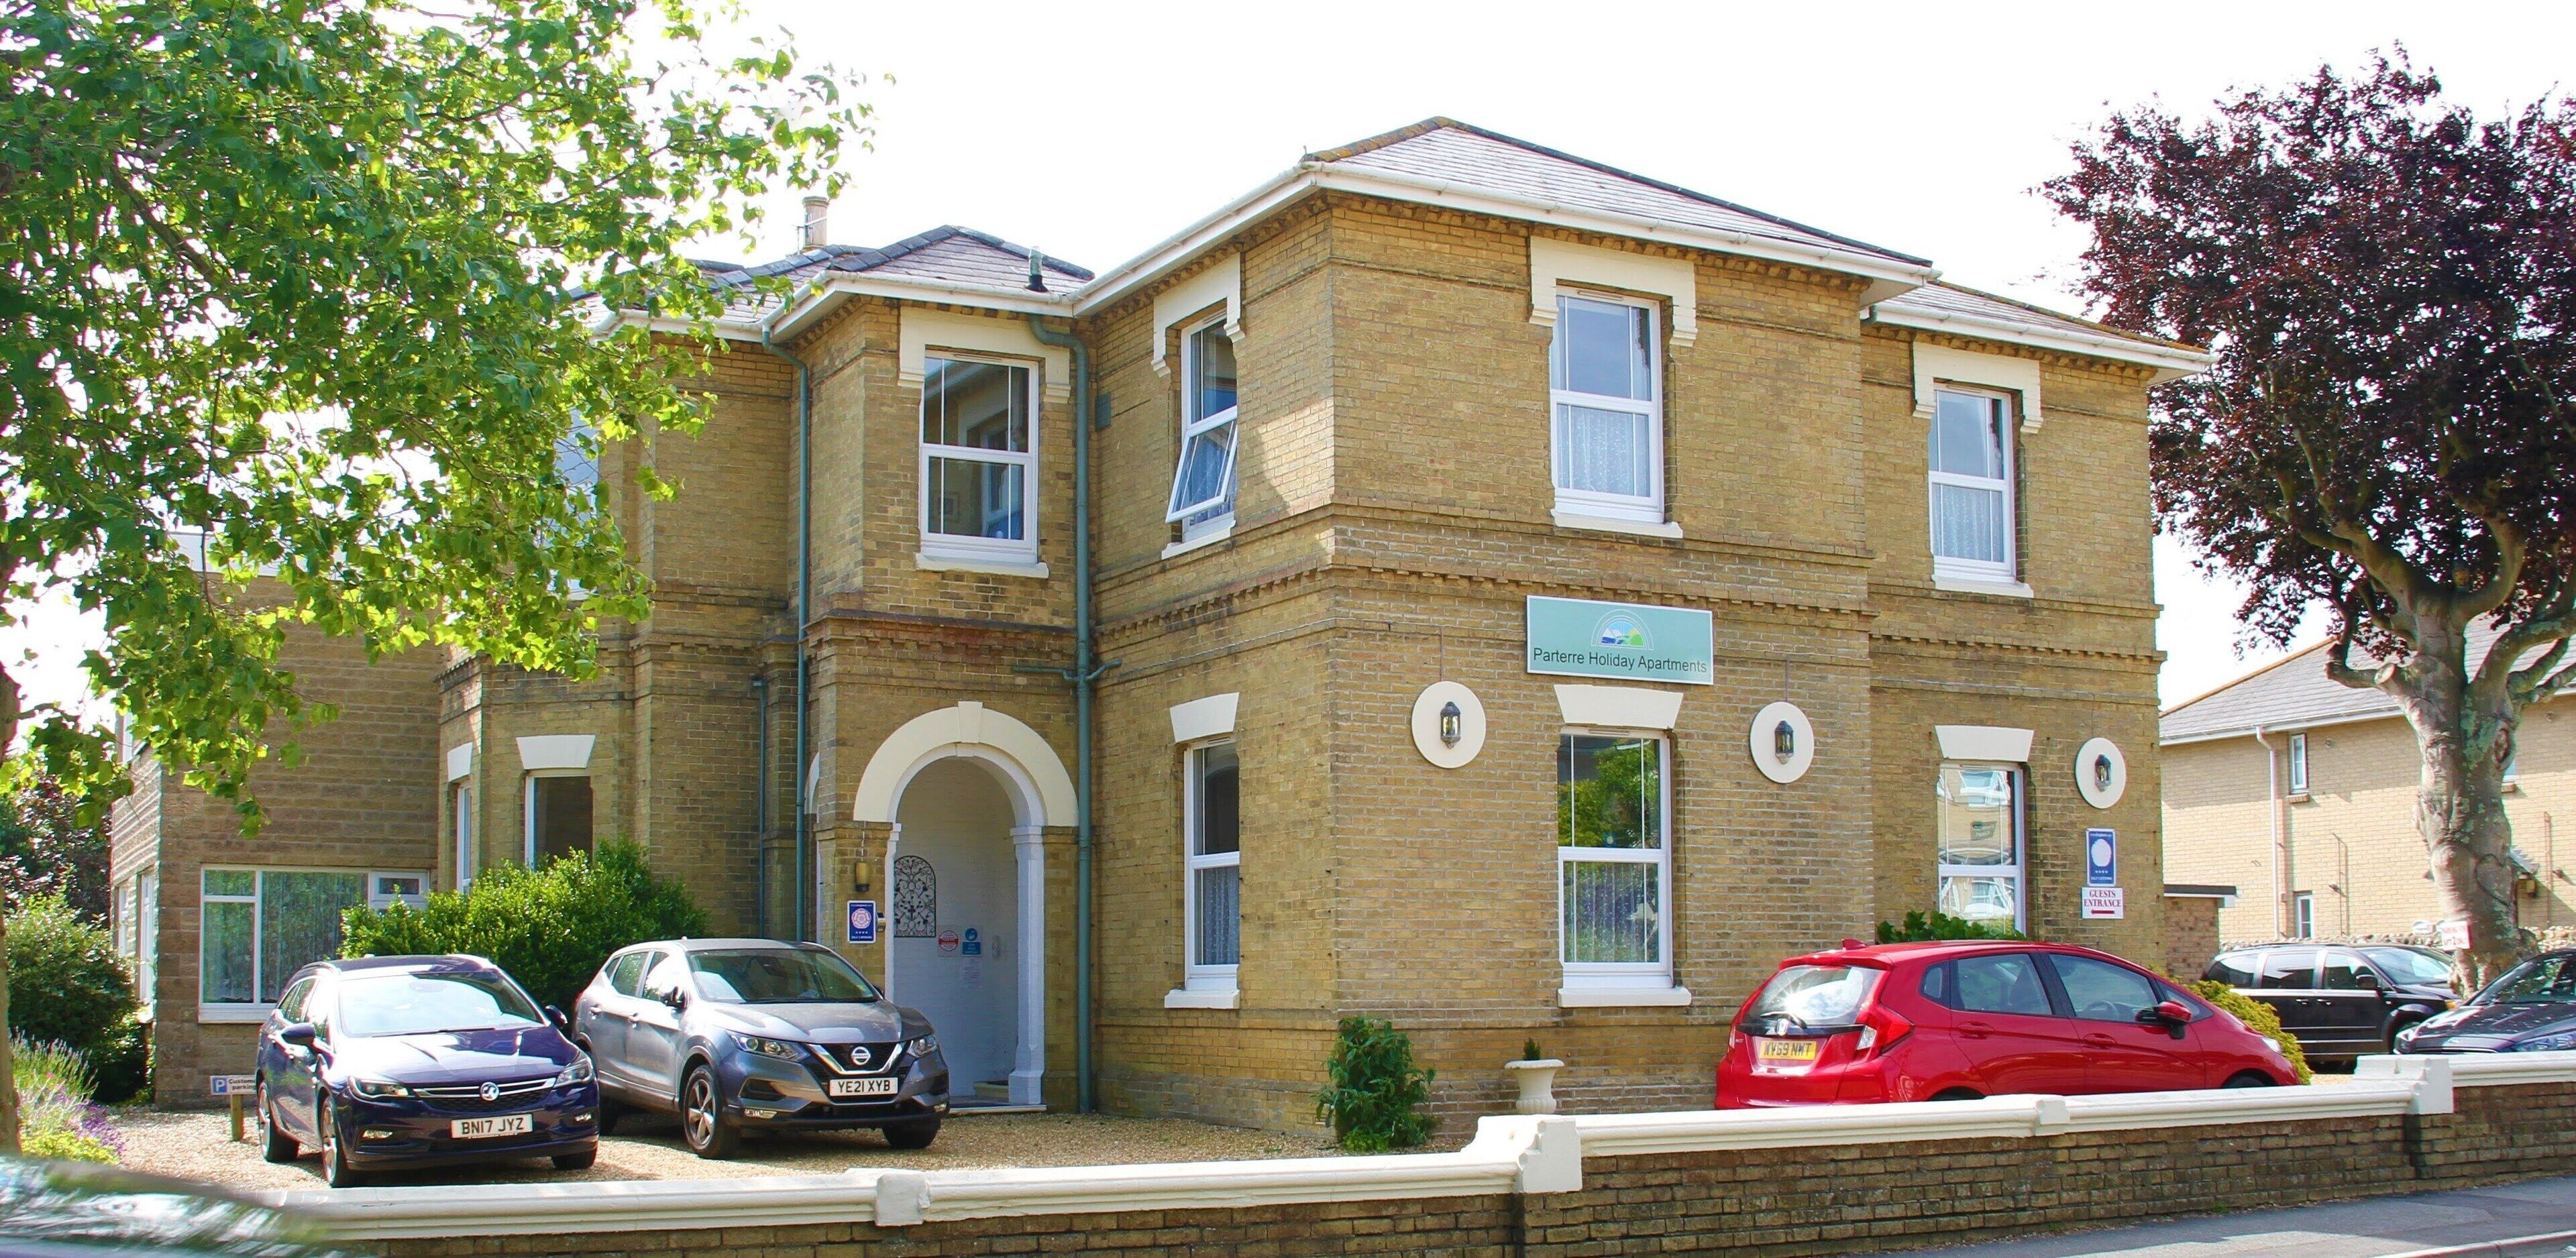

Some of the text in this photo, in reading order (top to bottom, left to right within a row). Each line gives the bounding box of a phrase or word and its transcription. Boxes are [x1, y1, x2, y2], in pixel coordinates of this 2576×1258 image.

[1534, 648, 1707, 673] Parterre Holiday Apartments
[2089, 889, 2116, 898] GUESTS
[2084, 899, 2122, 907] ENTRANCE
[838, 1080, 890, 1093] YE21 XYB
[461, 1117, 524, 1135] BN17 JYZ
